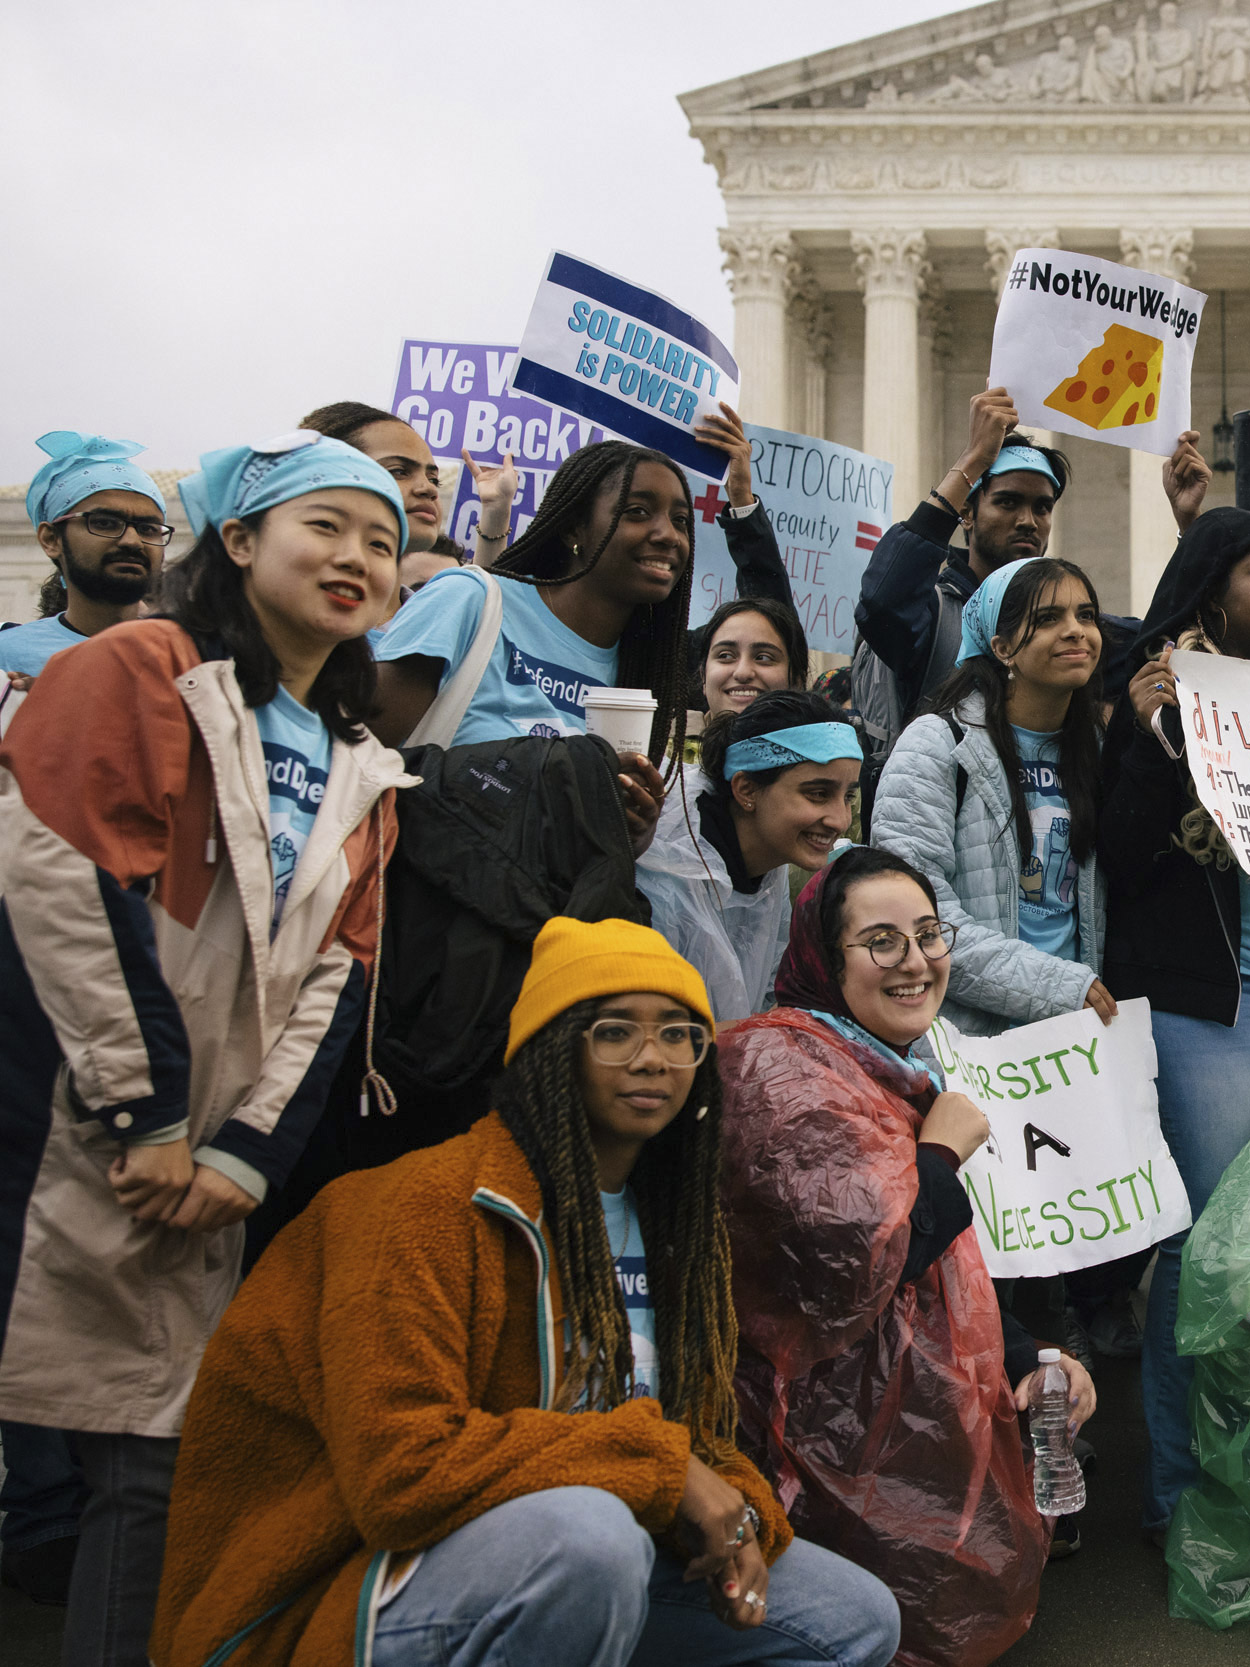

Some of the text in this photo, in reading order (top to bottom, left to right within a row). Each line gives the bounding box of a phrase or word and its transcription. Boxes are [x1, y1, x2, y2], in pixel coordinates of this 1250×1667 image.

[1039, 163, 1133, 185] EQUAL
[1141, 163, 1247, 185] JUSTICE
[1009, 262, 1198, 338] #NotYourWedge
[410, 346, 476, 395] We
[567, 300, 721, 397] SOLIDARITY
[575, 342, 600, 378] is
[600, 353, 699, 425] POWER
[397, 395, 454, 449] Go
[749, 438, 892, 514] RITOCRACY
[764, 508, 840, 549] nequity
[777, 544, 831, 586] HITE
[1023, 1122, 1072, 1172] A
[964, 1159, 1160, 1252] NECESSITY
